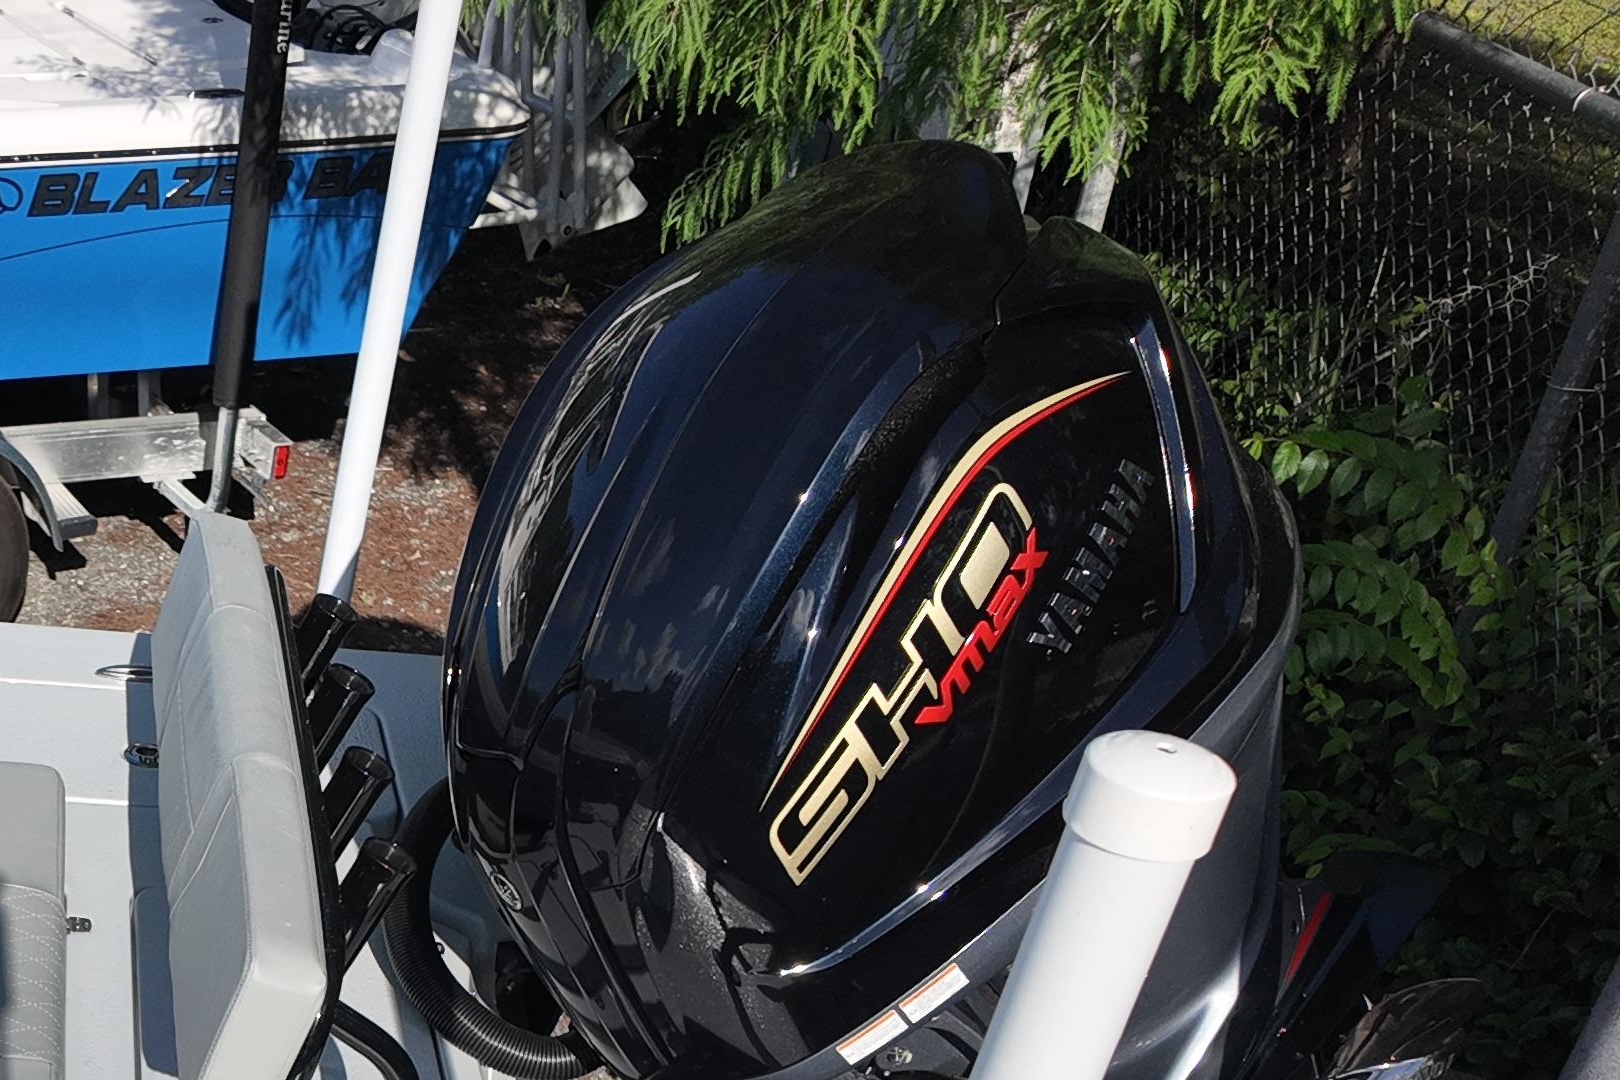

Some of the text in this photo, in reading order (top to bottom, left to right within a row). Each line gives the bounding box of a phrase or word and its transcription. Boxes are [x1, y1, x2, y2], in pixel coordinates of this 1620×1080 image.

[303, 153, 394, 200] BA
[1027, 457, 1156, 657] YAMAHA
[769, 482, 1033, 887] SHO
